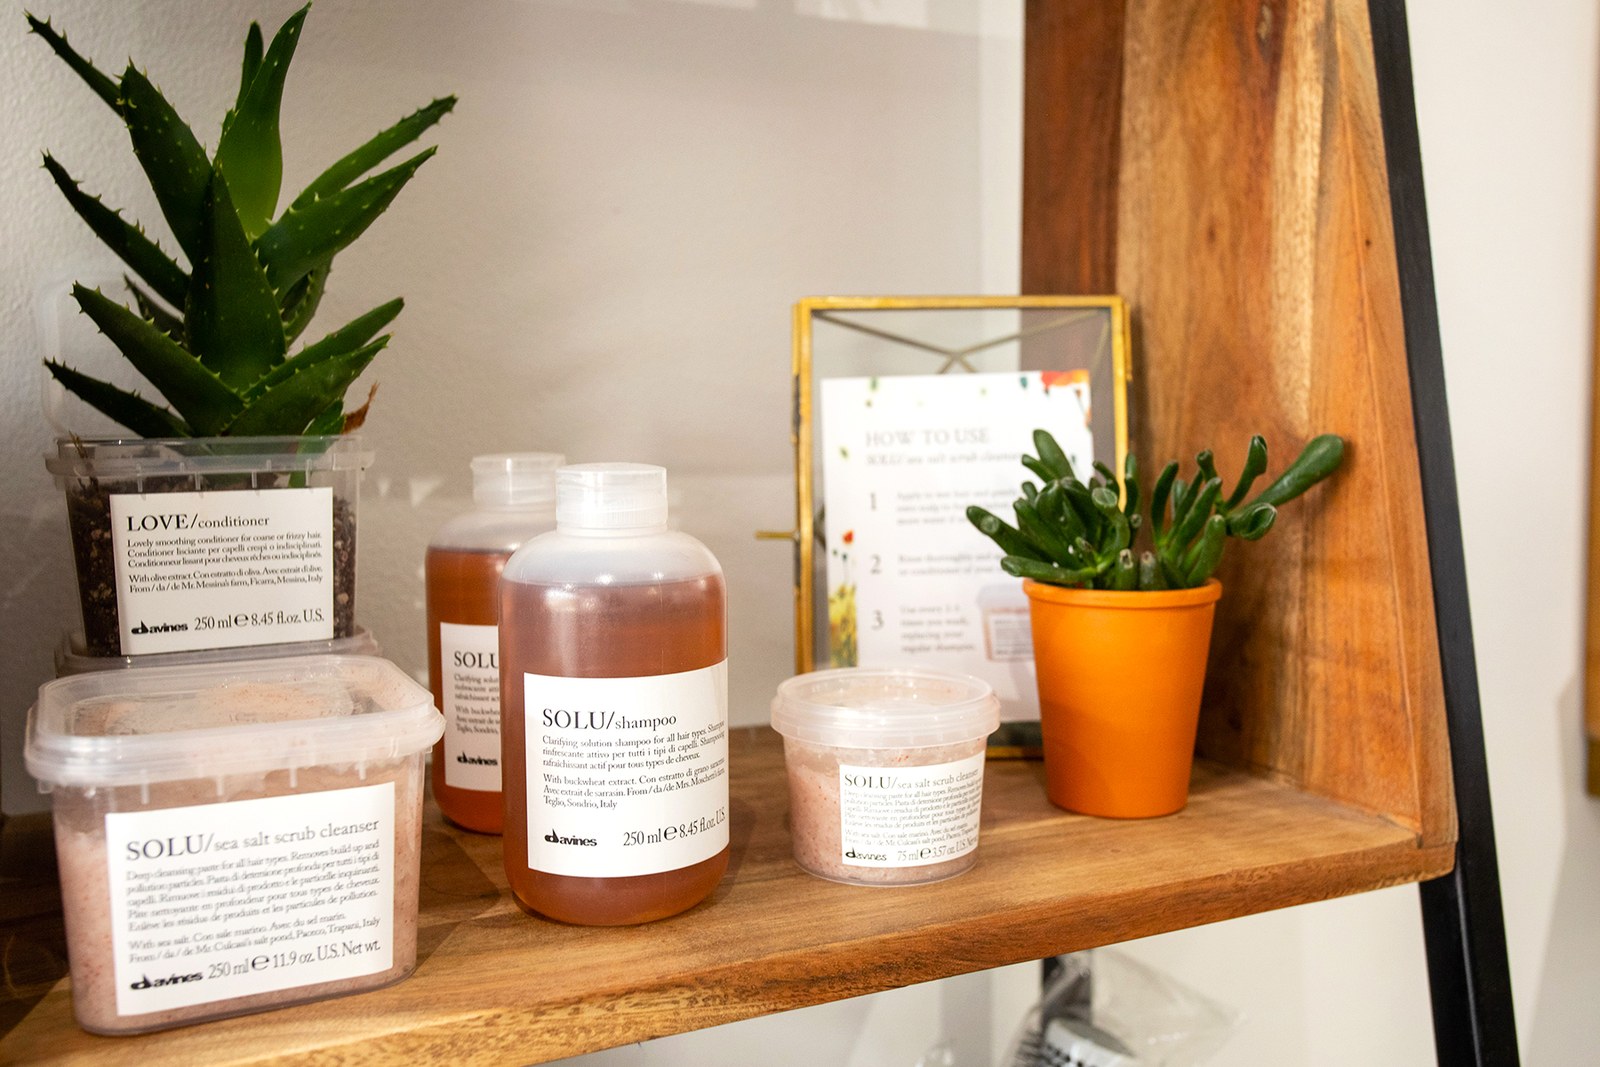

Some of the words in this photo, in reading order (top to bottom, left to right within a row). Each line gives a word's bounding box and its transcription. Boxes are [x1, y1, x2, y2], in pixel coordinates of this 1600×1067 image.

[866, 430, 915, 447] HOW
[922, 429, 950, 445] TO
[954, 426, 990, 444] USE
[869, 491, 877, 511] 1
[126, 513, 270, 532] LOVE/conditioner
[127, 539, 153, 550] Lovely
[155, 537, 197, 547] smoothing
[197, 535, 239, 544] conditioner
[241, 533, 251, 542] for
[286, 531, 306, 541] frizzy
[307, 530, 322, 539] hair.
[127, 549, 174, 558] Conditioner
[176, 547, 206, 556] lisciante
[208, 548, 220, 556] per
[222, 543, 245, 554] capelli
[247, 544, 268, 553] crespi
[276, 541, 322, 551] indisciplinati.
[127, 558, 181, 568] Conditionneur
[204, 558, 221, 566] pour
[222, 554, 249, 563] cheveux
[870, 554, 882, 575] 2
[129, 573, 150, 583] With
[150, 573, 167, 582] olive
[167, 571, 193, 581] extract.
[193, 571, 209, 579] Con
[211, 568, 236, 578] estratto
[236, 568, 244, 576] di
[244, 567, 261, 576] oliva.
[262, 566, 279, 575] Avec
[280, 565, 301, 574] extrait
[129, 584, 150, 593] From
[181, 580, 196, 590] Mr.
[230, 578, 250, 588] farm,
[307, 574, 323, 584] Italy
[131, 620, 188, 635] davines
[194, 616, 216, 631] 250
[217, 614, 232, 629] ml
[251, 611, 274, 627] 8.45
[303, 608, 325, 622] U.S.
[871, 609, 884, 631] 3
[542, 707, 678, 731] SOLU/shampoo
[542, 734, 578, 749] Clarifying
[580, 738, 612, 748] solution
[615, 737, 651, 749] shampoo
[653, 735, 664, 745] for
[666, 732, 676, 743] all
[677, 730, 690, 741] hair
[456, 750, 499, 766] davines
[542, 747, 584, 759] rinfrescante
[586, 750, 610, 759] attivo
[612, 751, 626, 761] per
[628, 748, 645, 758] tutti
[653, 745, 666, 757] tipi
[668, 744, 676, 753] di
[678, 740, 699, 753] capelli.
[589, 760, 606, 769] actif
[607, 761, 626, 772] pour
[627, 761, 644, 770] tous
[645, 758, 665, 769] types
[665, 755, 674, 764] de
[543, 773, 562, 784] With
[564, 775, 606, 787] buckwheat
[608, 778, 637, 787] extract.
[638, 775, 656, 785] Con
[658, 771, 685, 783] estratto
[685, 768, 693, 777] di
[693, 765, 710, 778] grano
[914, 778, 930, 789] salt
[932, 774, 955, 787] scrub
[543, 784, 560, 795] Avec
[560, 787, 583, 797] extrait
[584, 788, 594, 797] de
[594, 788, 626, 798] sarrasin.
[626, 787, 648, 797] From
[543, 795, 566, 808] Teglio,
[567, 798, 599, 809] Sondrio,
[600, 799, 618, 811] Italy
[243, 831, 270, 848] salt
[274, 825, 316, 844] scrub
[320, 820, 379, 838] cleanser
[544, 828, 598, 847] davines
[623, 830, 645, 847] 250
[647, 828, 662, 845] ml
[679, 819, 699, 839] 8.45
[845, 846, 887, 861] davines
[897, 850, 907, 862] 75
[908, 849, 919, 862] ml
[362, 917, 382, 928] Italy
[130, 972, 204, 990] davines
[207, 961, 231, 980] 250
[233, 958, 250, 975] ml
[317, 943, 340, 961] U.S.
[341, 941, 362, 958] Net
